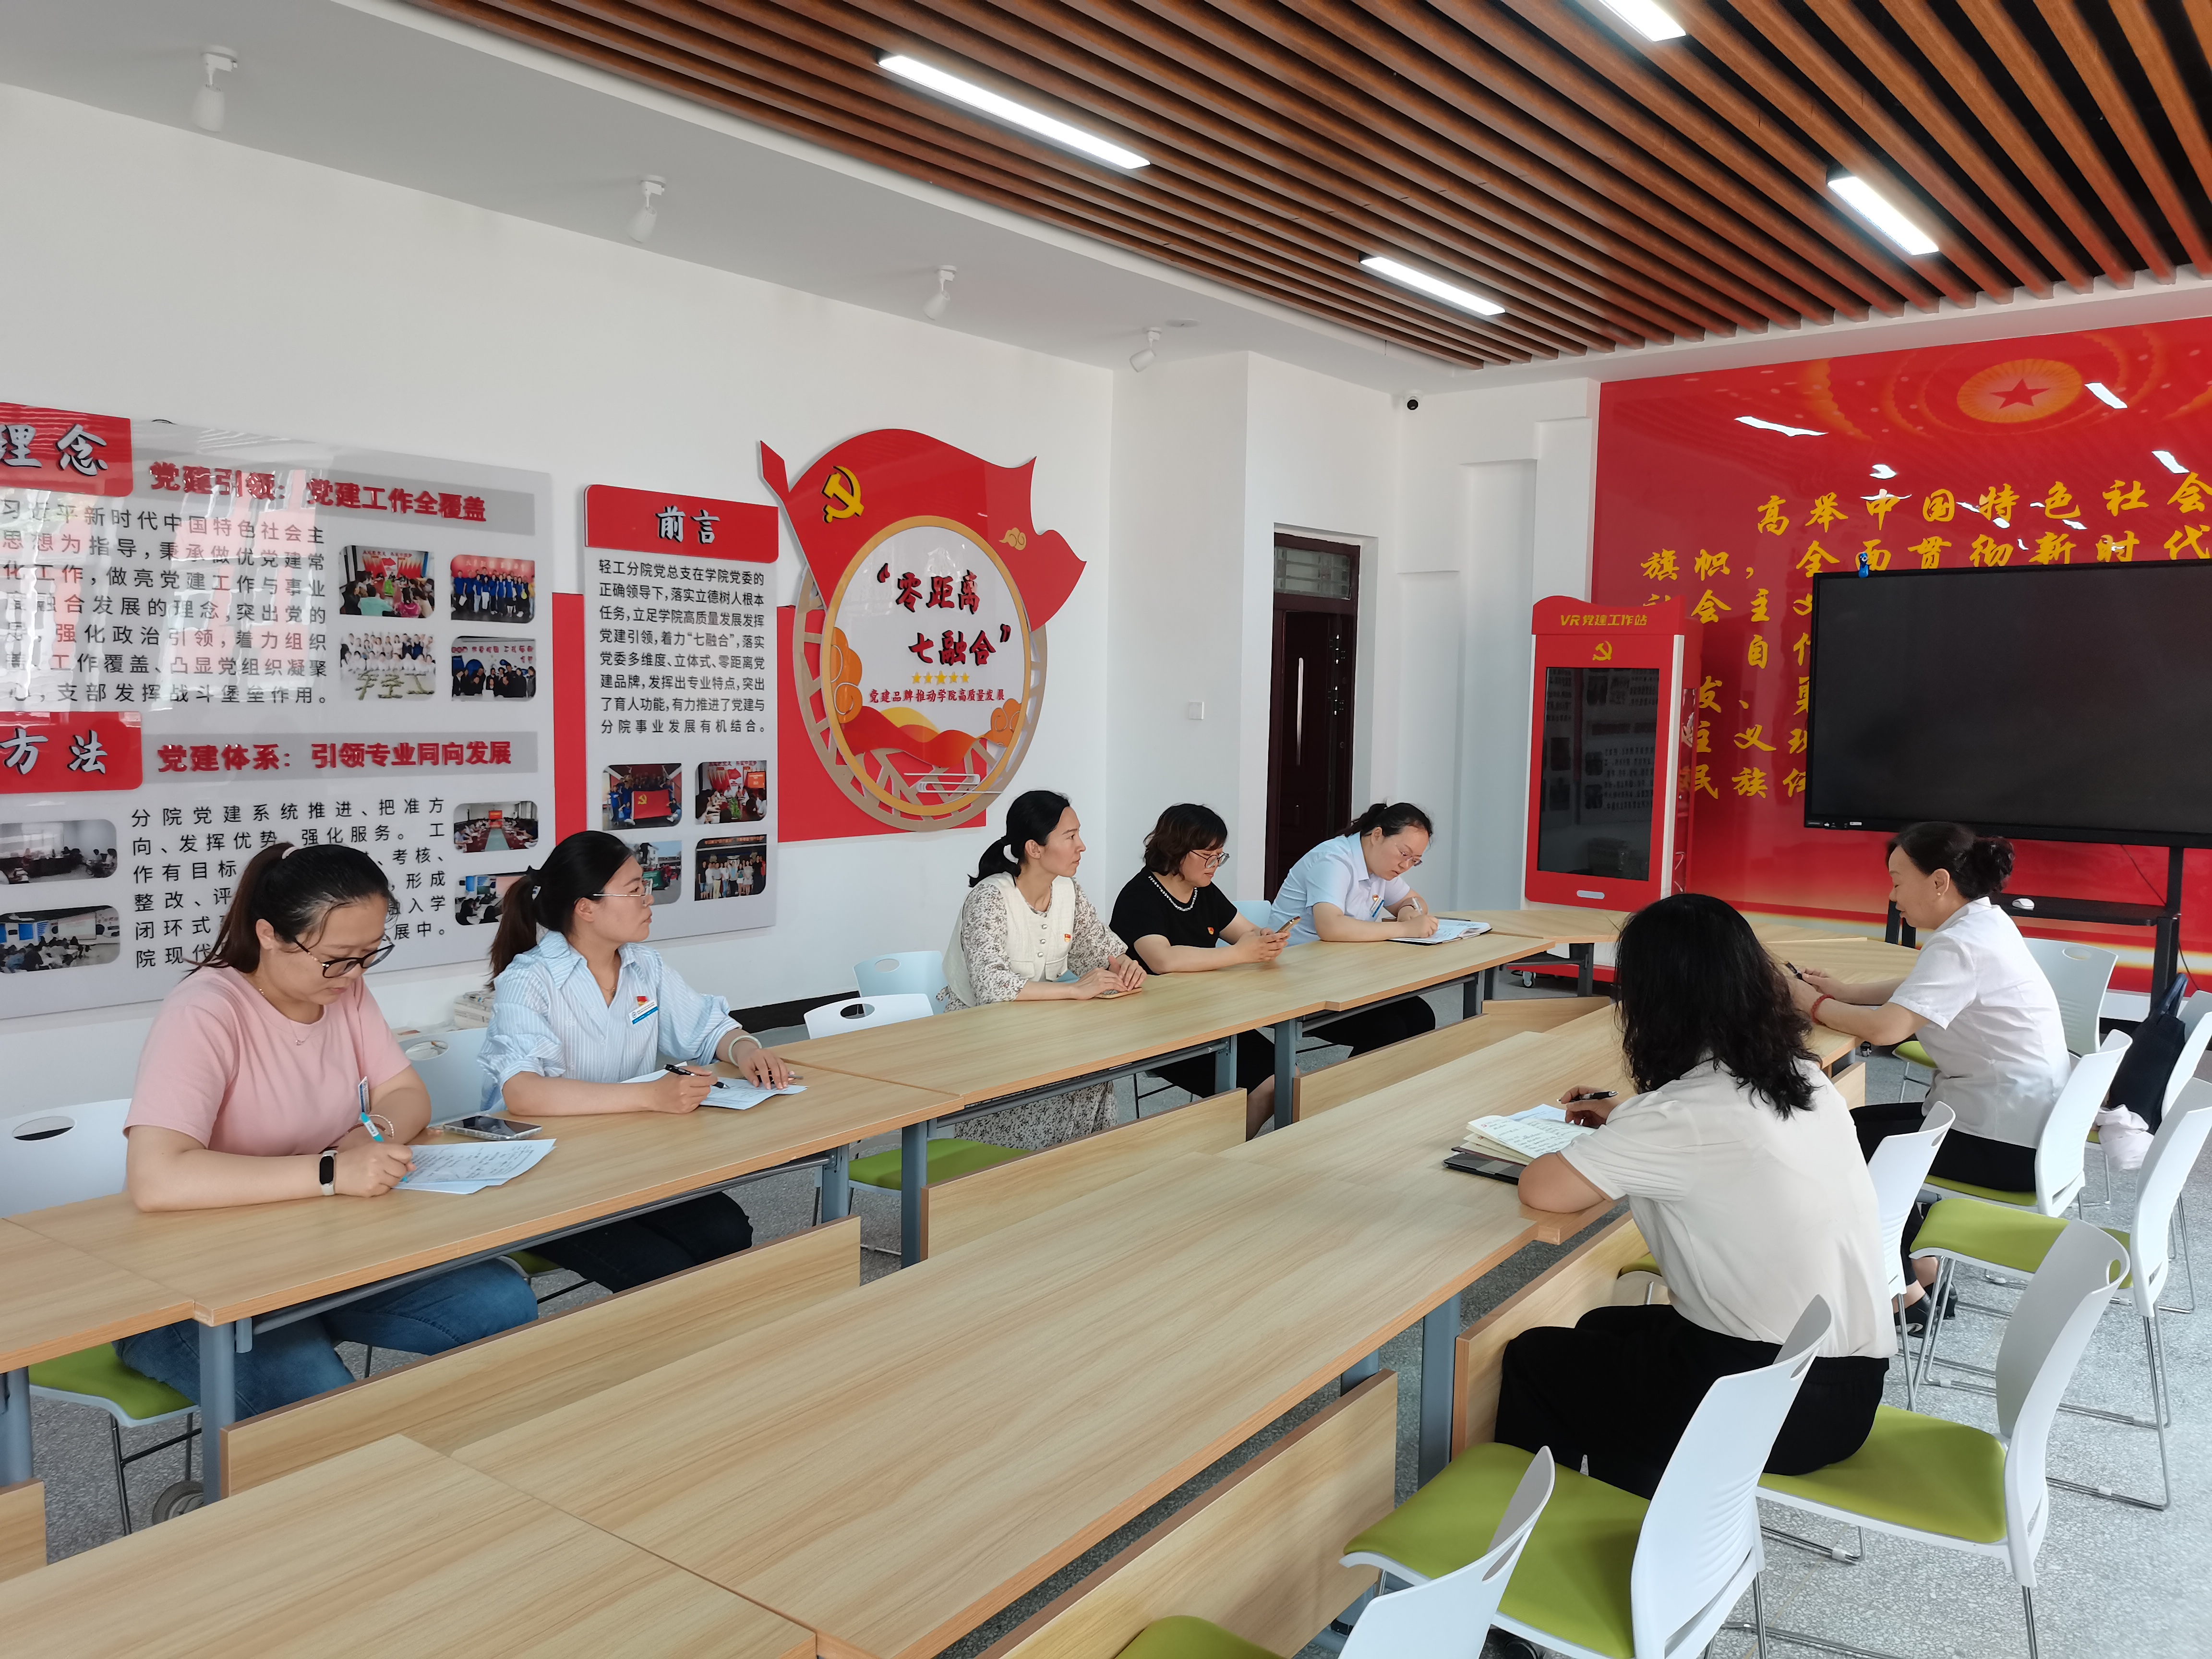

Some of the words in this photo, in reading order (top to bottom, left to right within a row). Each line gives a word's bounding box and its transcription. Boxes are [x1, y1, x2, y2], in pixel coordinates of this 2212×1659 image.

[0, 424, 107, 476] 理念
[655, 505, 720, 544] 前言
[3, 560, 326, 598] 化工作，做亮党建工作与事业
[599, 559, 764, 586] 轻工分院党总支在学院党委的
[599, 582, 764, 607] 正确领导下，落实立德树人根本
[1643, 589, 1812, 624] 会主
[599, 605, 764, 628] 任务，立足学院高质量发展发挥
[600, 650, 765, 671] 党委多维度、立体式、零距离党
[600, 673, 765, 692] 建品牌，发挥出专业特点，突出
[601, 696, 765, 712] 了育人功能，有力推进了党建与
[869, 688, 1005, 704] 党建品牌推动学院高质量发展
[601, 719, 765, 734] 分院事业发展有机结合。
[0, 728, 108, 775] 方法
[132, 797, 445, 827] 分院党建系统推进、把准方
[135, 915, 225, 940] 闭环式
